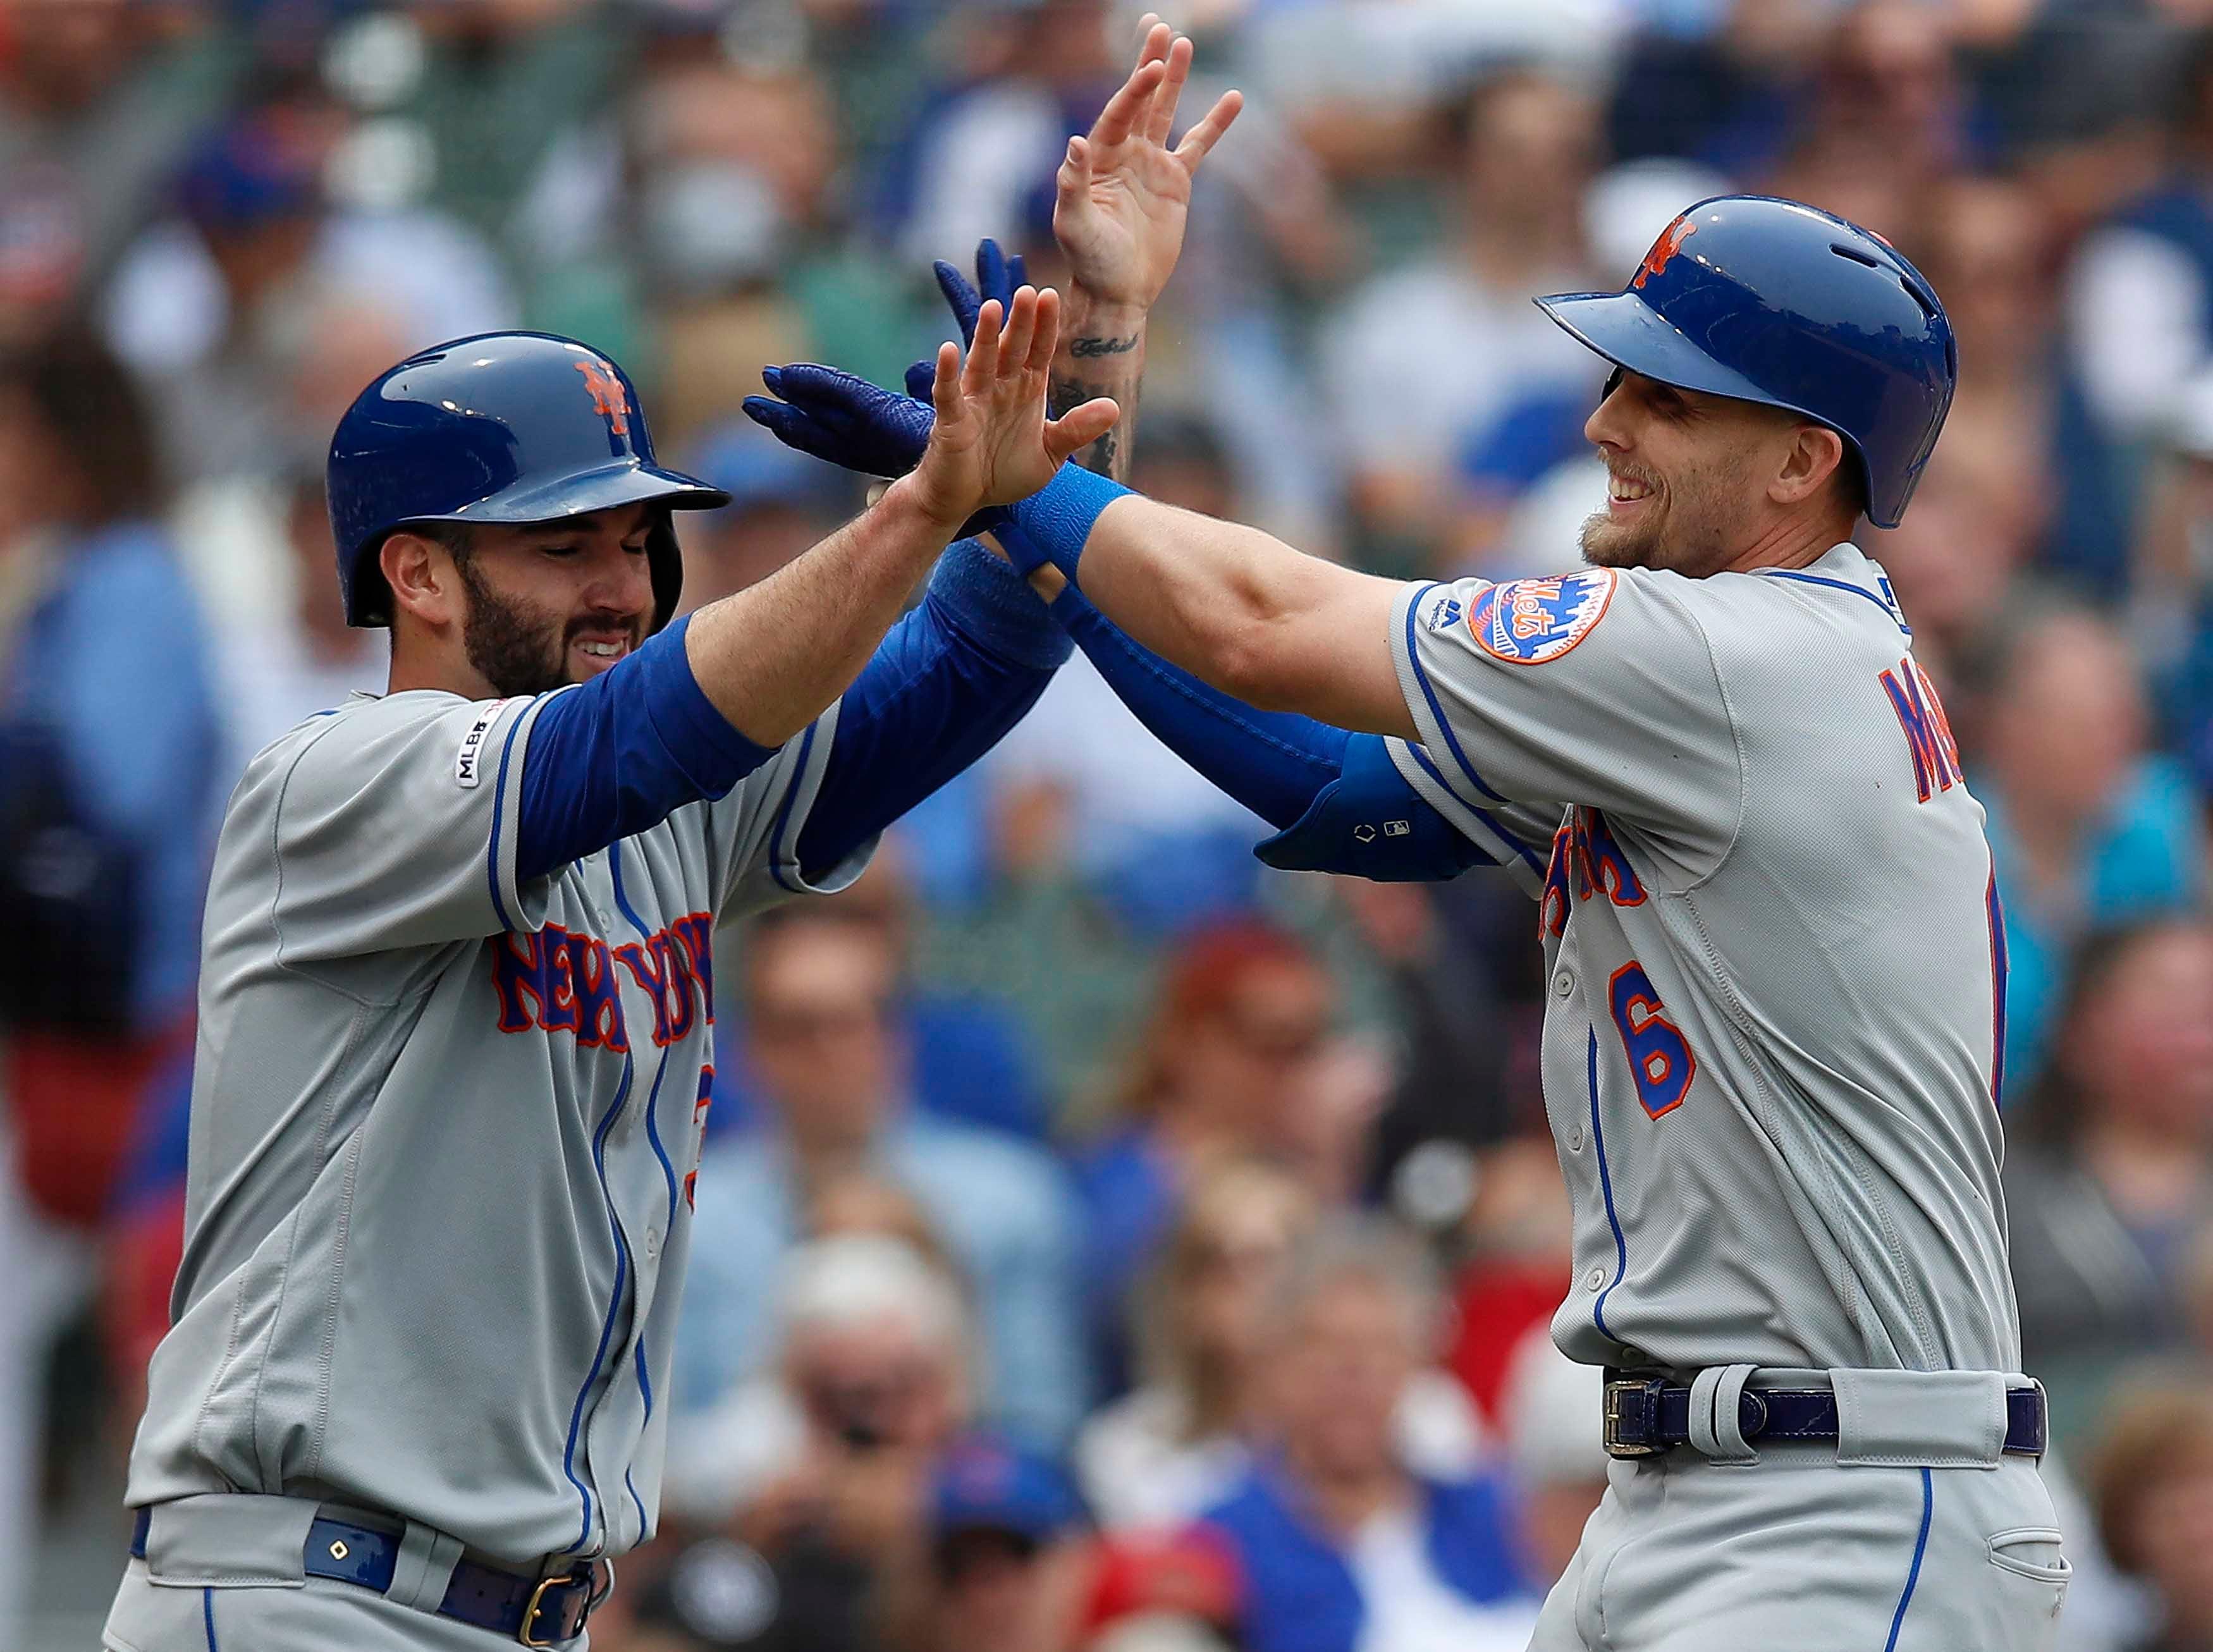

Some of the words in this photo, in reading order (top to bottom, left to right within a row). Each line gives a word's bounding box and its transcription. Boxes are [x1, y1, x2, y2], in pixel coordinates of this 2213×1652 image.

[1512, 580, 1562, 639] Mets
[458, 733, 481, 780] MLB
[492, 921, 628, 1053] NEW
[1607, 959, 1697, 1122] 6
